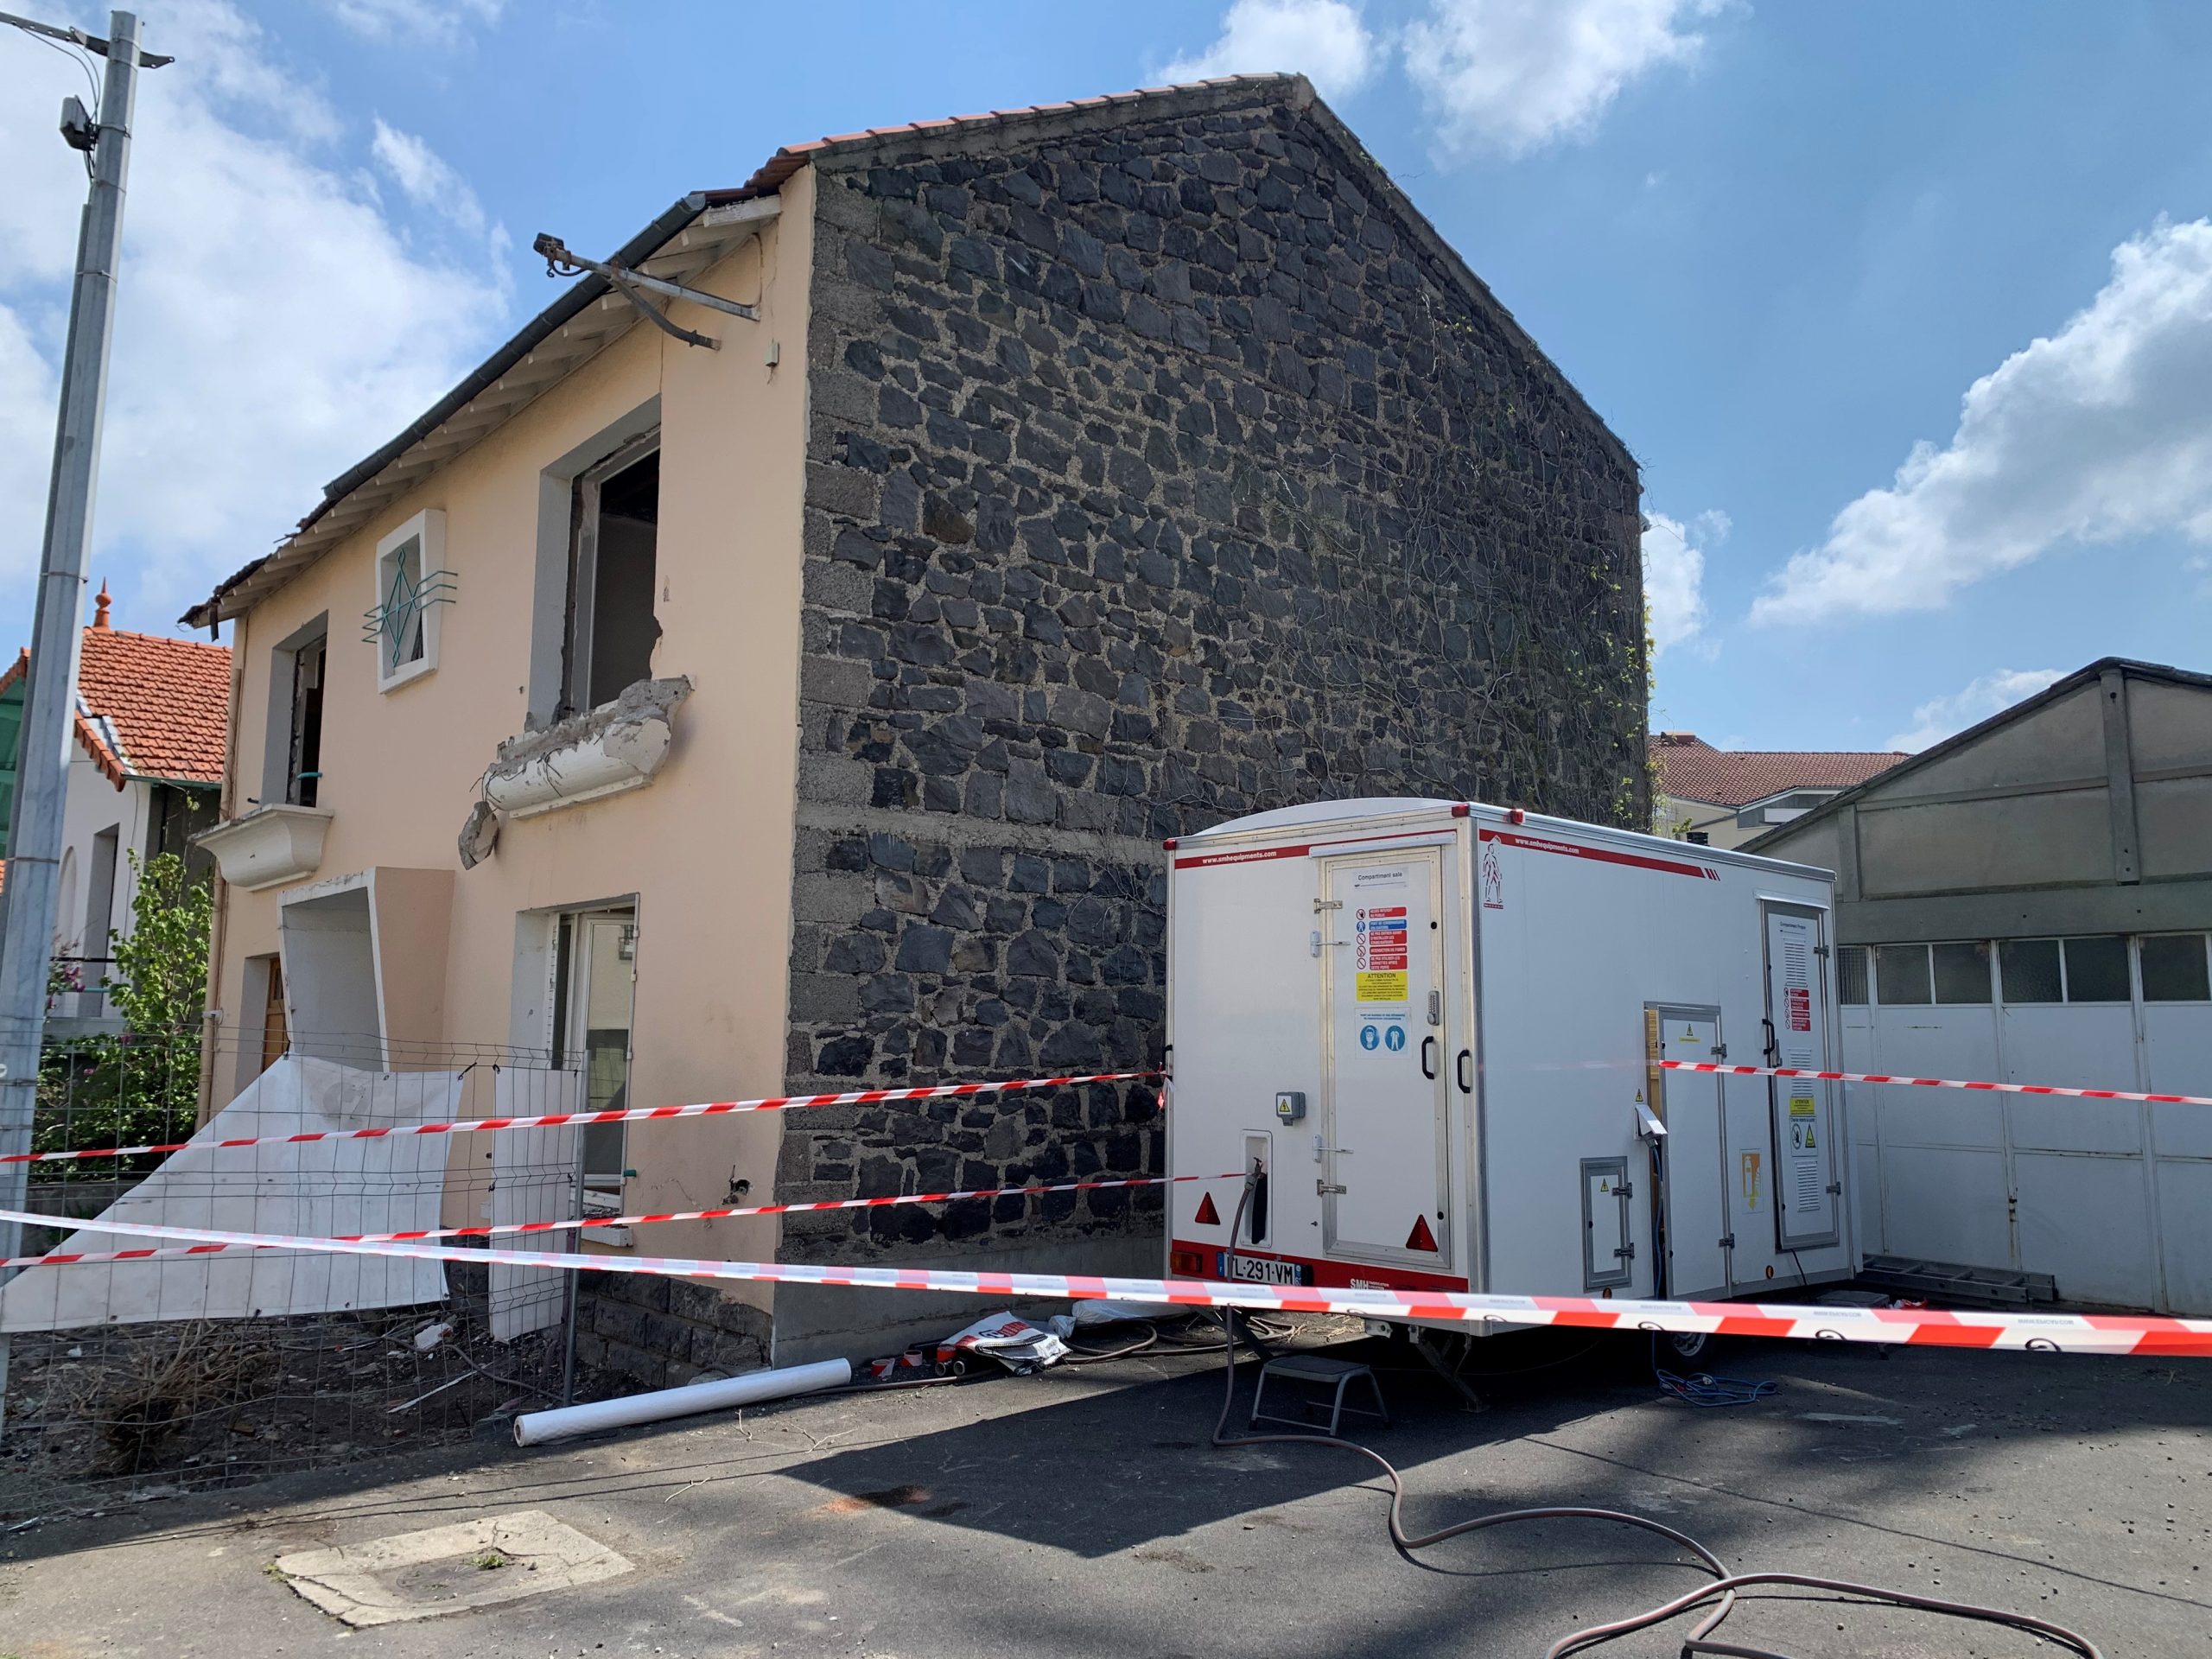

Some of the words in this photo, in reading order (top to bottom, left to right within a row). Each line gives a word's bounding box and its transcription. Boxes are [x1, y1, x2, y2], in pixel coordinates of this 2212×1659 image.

[1515, 838, 1580, 855] www.smhequipments.com
[1202, 851, 1277, 864] www.smhequipments.com
[1350, 1278, 1370, 1290] SMH
